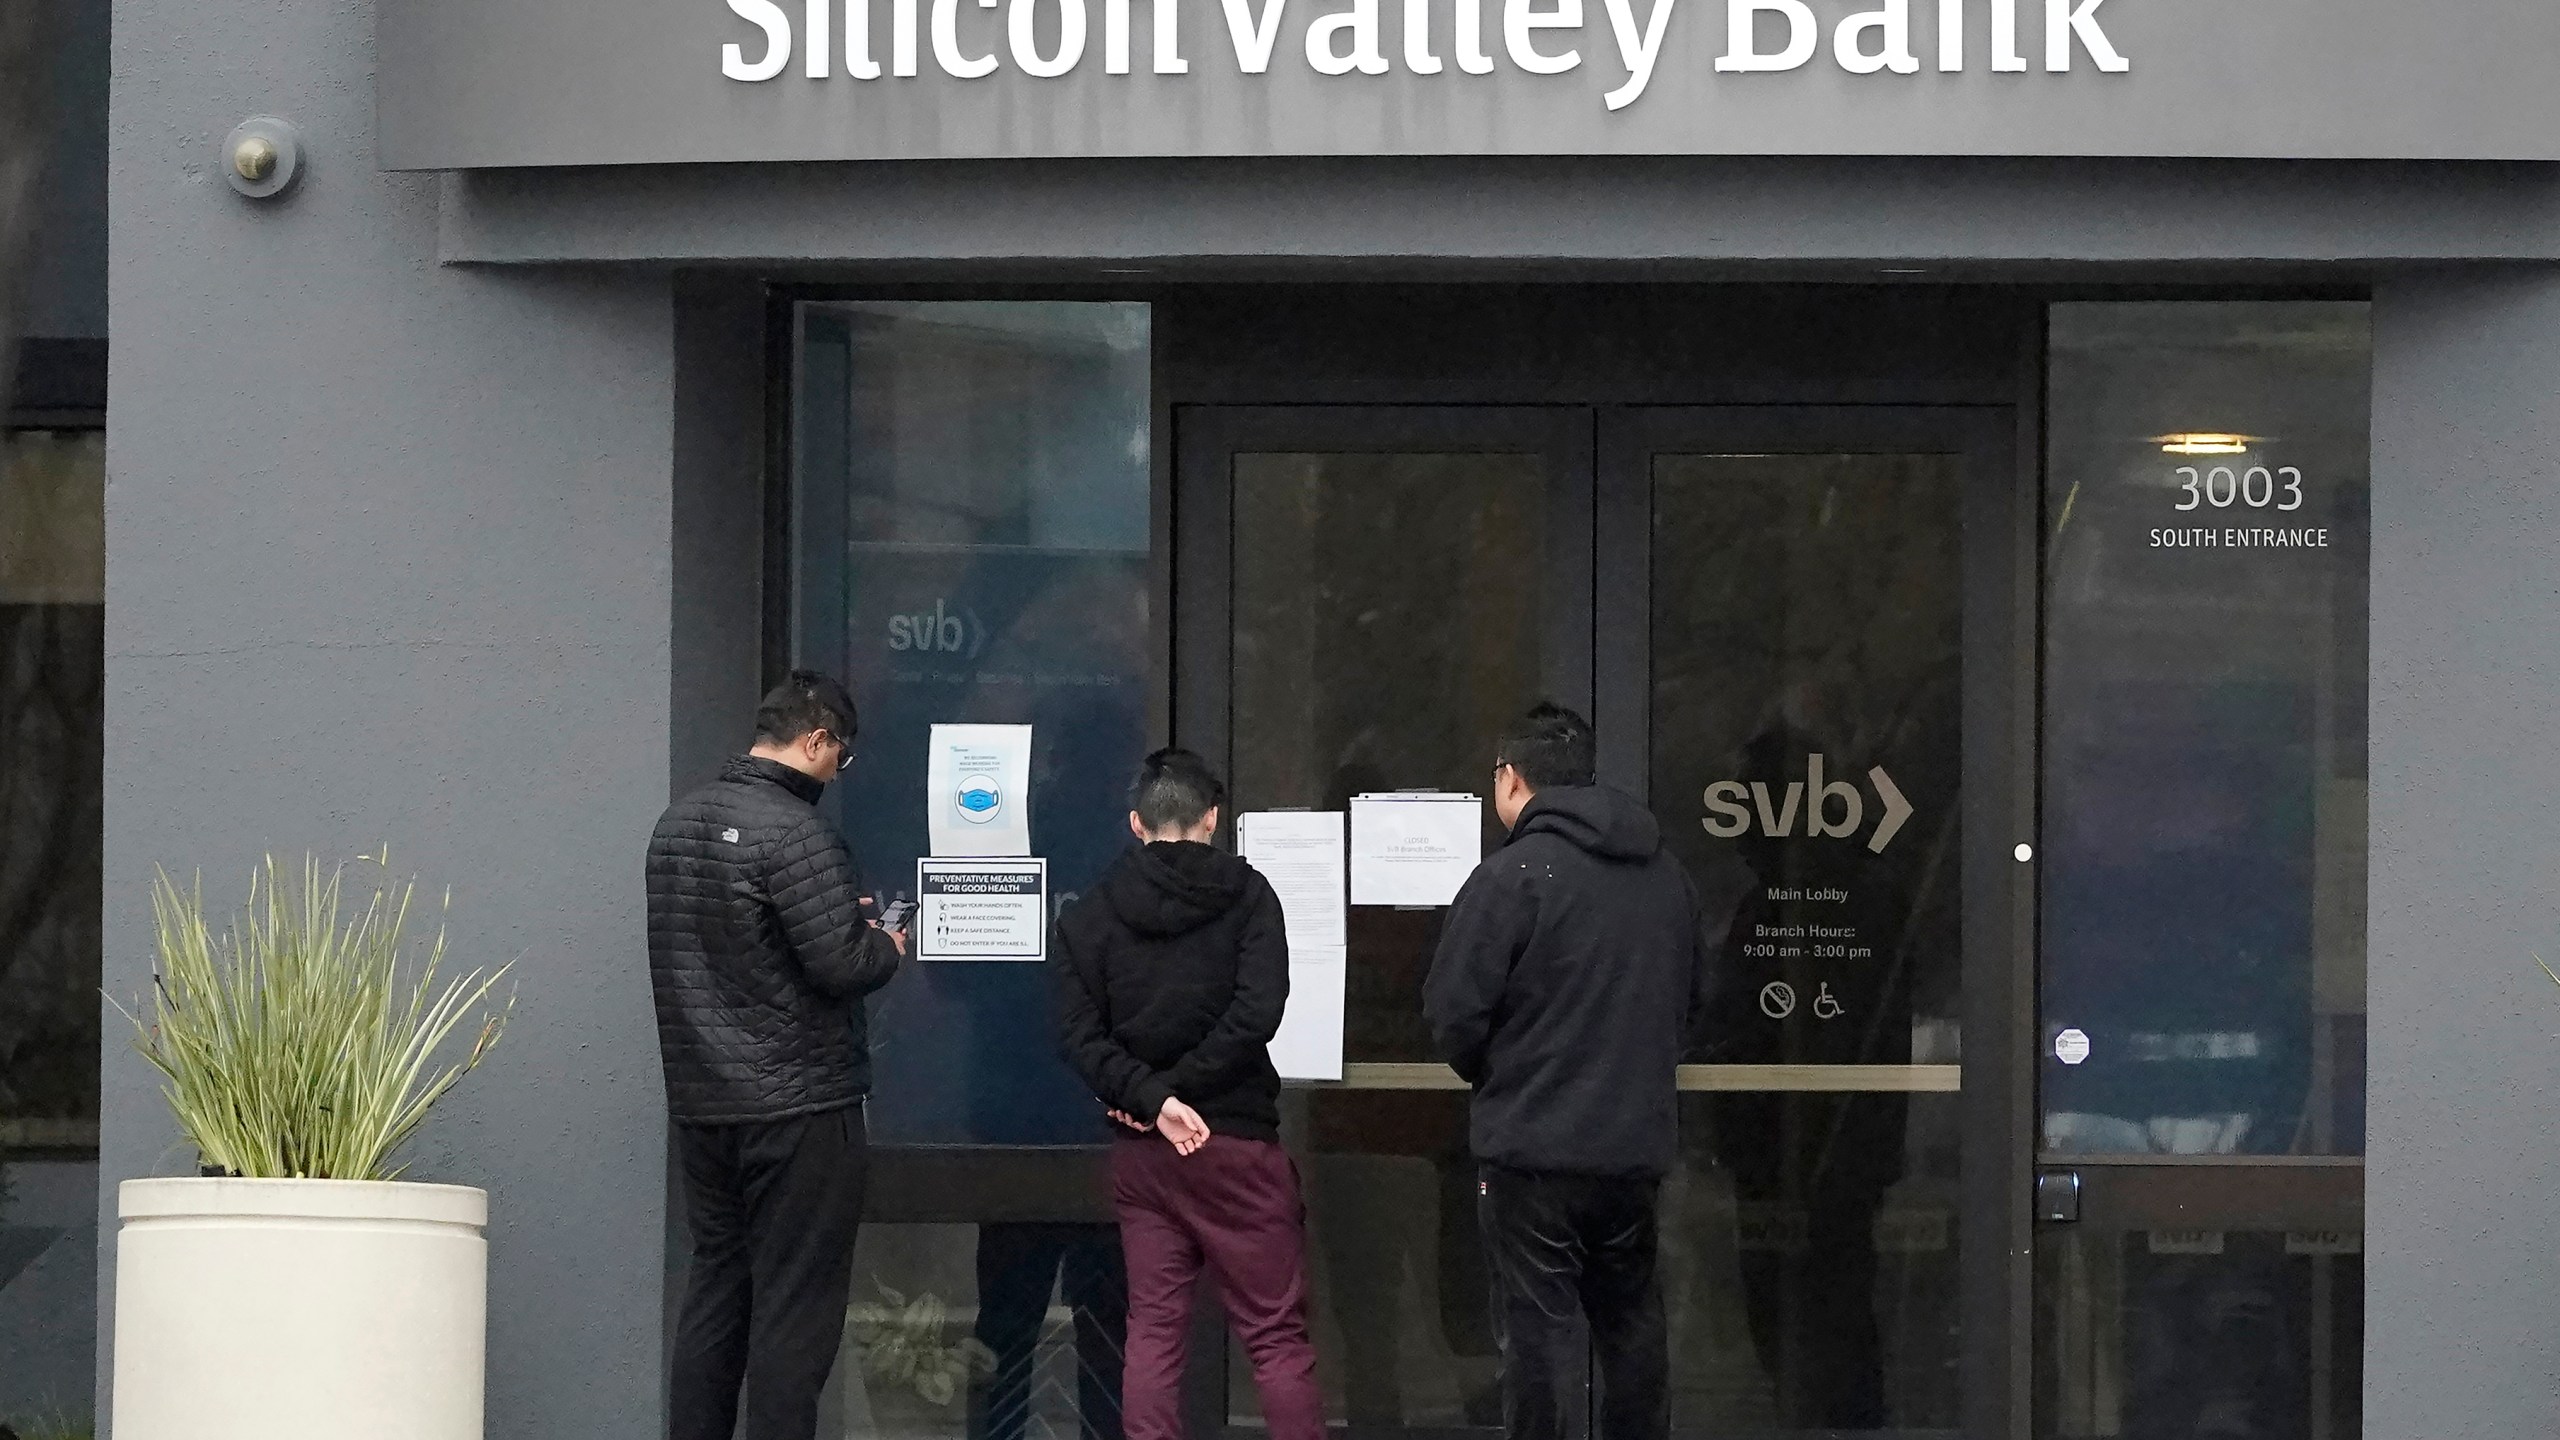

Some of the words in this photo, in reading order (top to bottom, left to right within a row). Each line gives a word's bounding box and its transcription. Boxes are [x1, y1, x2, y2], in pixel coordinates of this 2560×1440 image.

[722, 0, 1188, 81] Silicon
[1219, 0, 1674, 111] Valley
[1714, 0, 2129, 75] Bank
[2174, 466, 2303, 511] 3003
[2150, 529, 2217, 547] SOUTH
[2225, 529, 2328, 547] ENTRANCE
[888, 598, 963, 651] svb
[1701, 753, 1863, 838] svb
[929, 875, 989, 883] PREVENTATIVE
[990, 875, 1034, 883] MEASURES
[943, 884, 960, 892] FOR
[961, 884, 987, 892] GOOD
[988, 884, 1020, 892] HEALTH
[1768, 887, 1802, 901] Main
[1806, 887, 1849, 904] Lobby
[1755, 924, 1805, 938] Branch
[1809, 924, 1856, 938] Hours:
[1743, 944, 1775, 958] 9:00
[1779, 947, 1801, 958] am
[1813, 944, 1845, 958] 3:00
[1849, 947, 1872, 961] pm
